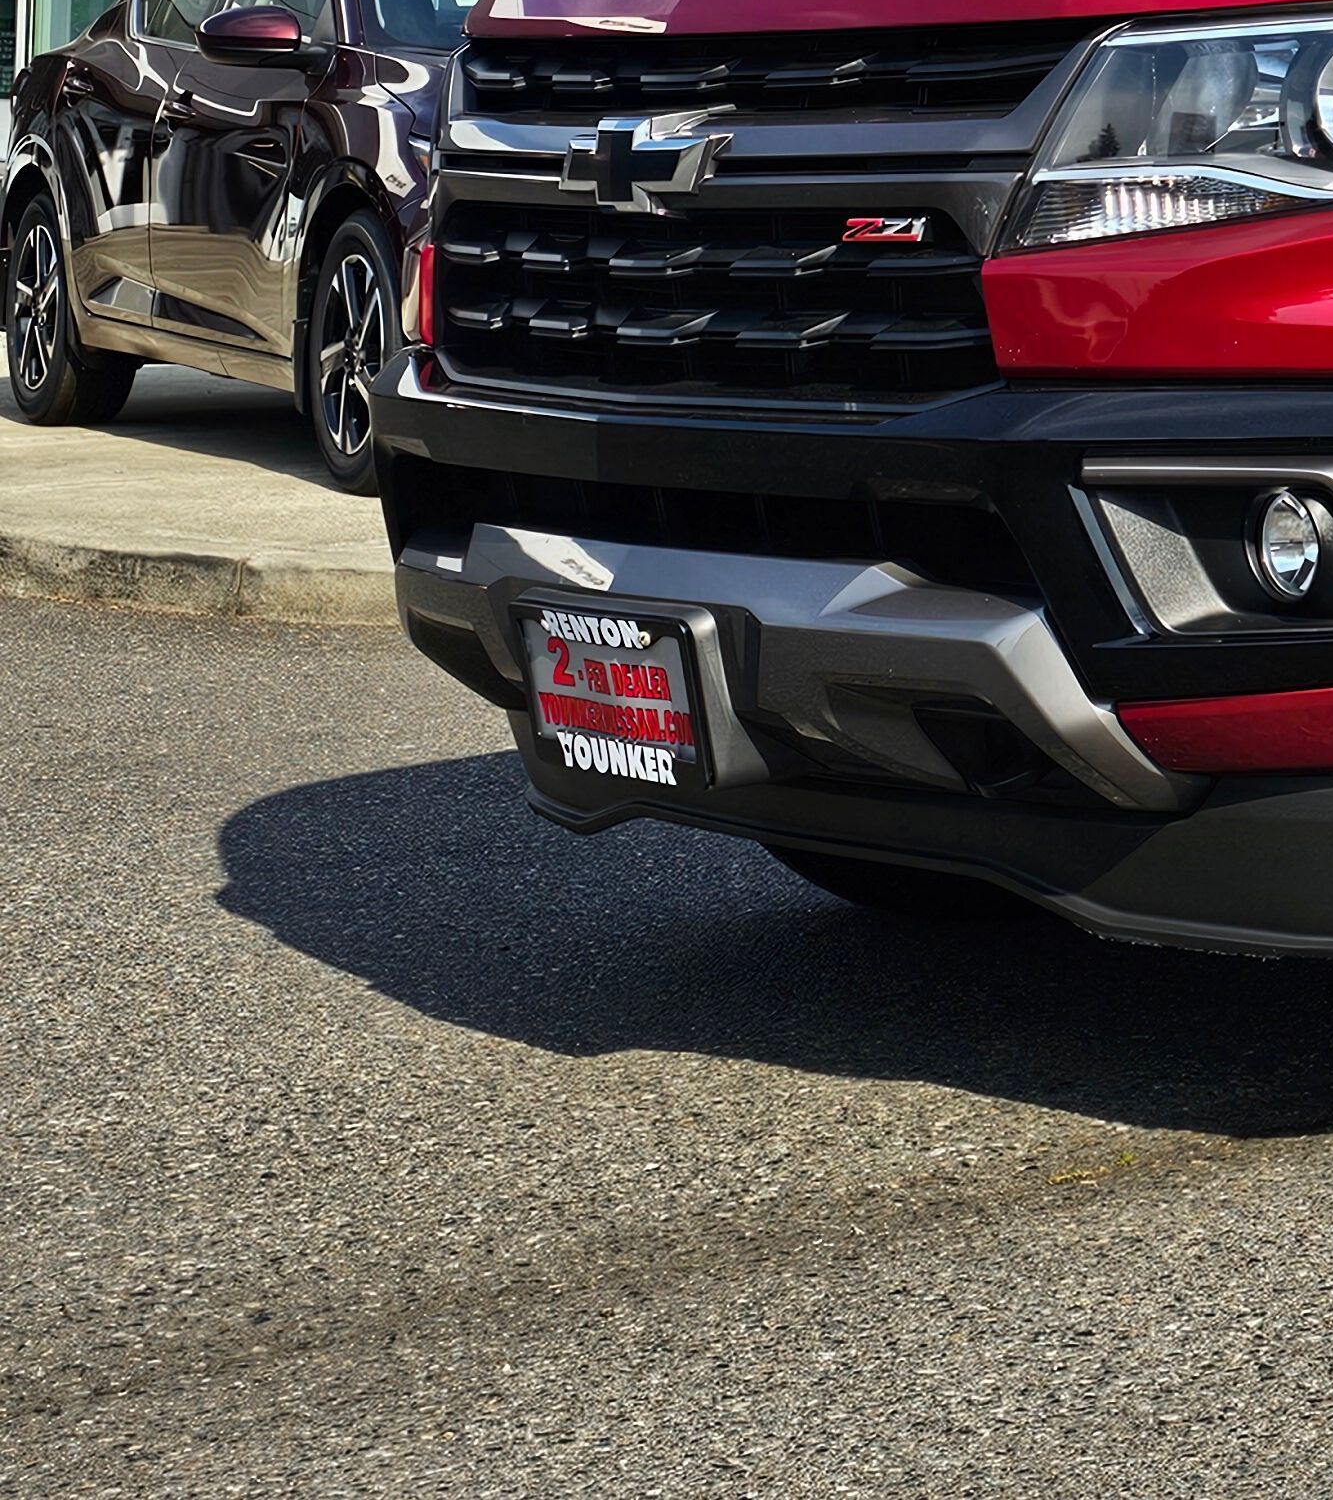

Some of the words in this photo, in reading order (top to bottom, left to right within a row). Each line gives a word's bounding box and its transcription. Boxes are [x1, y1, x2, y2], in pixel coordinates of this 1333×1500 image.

[842, 217, 926, 241] Z71
[542, 610, 644, 650] RENTON
[610, 662, 671, 701] DEALER
[557, 731, 677, 786] YOUNKER
